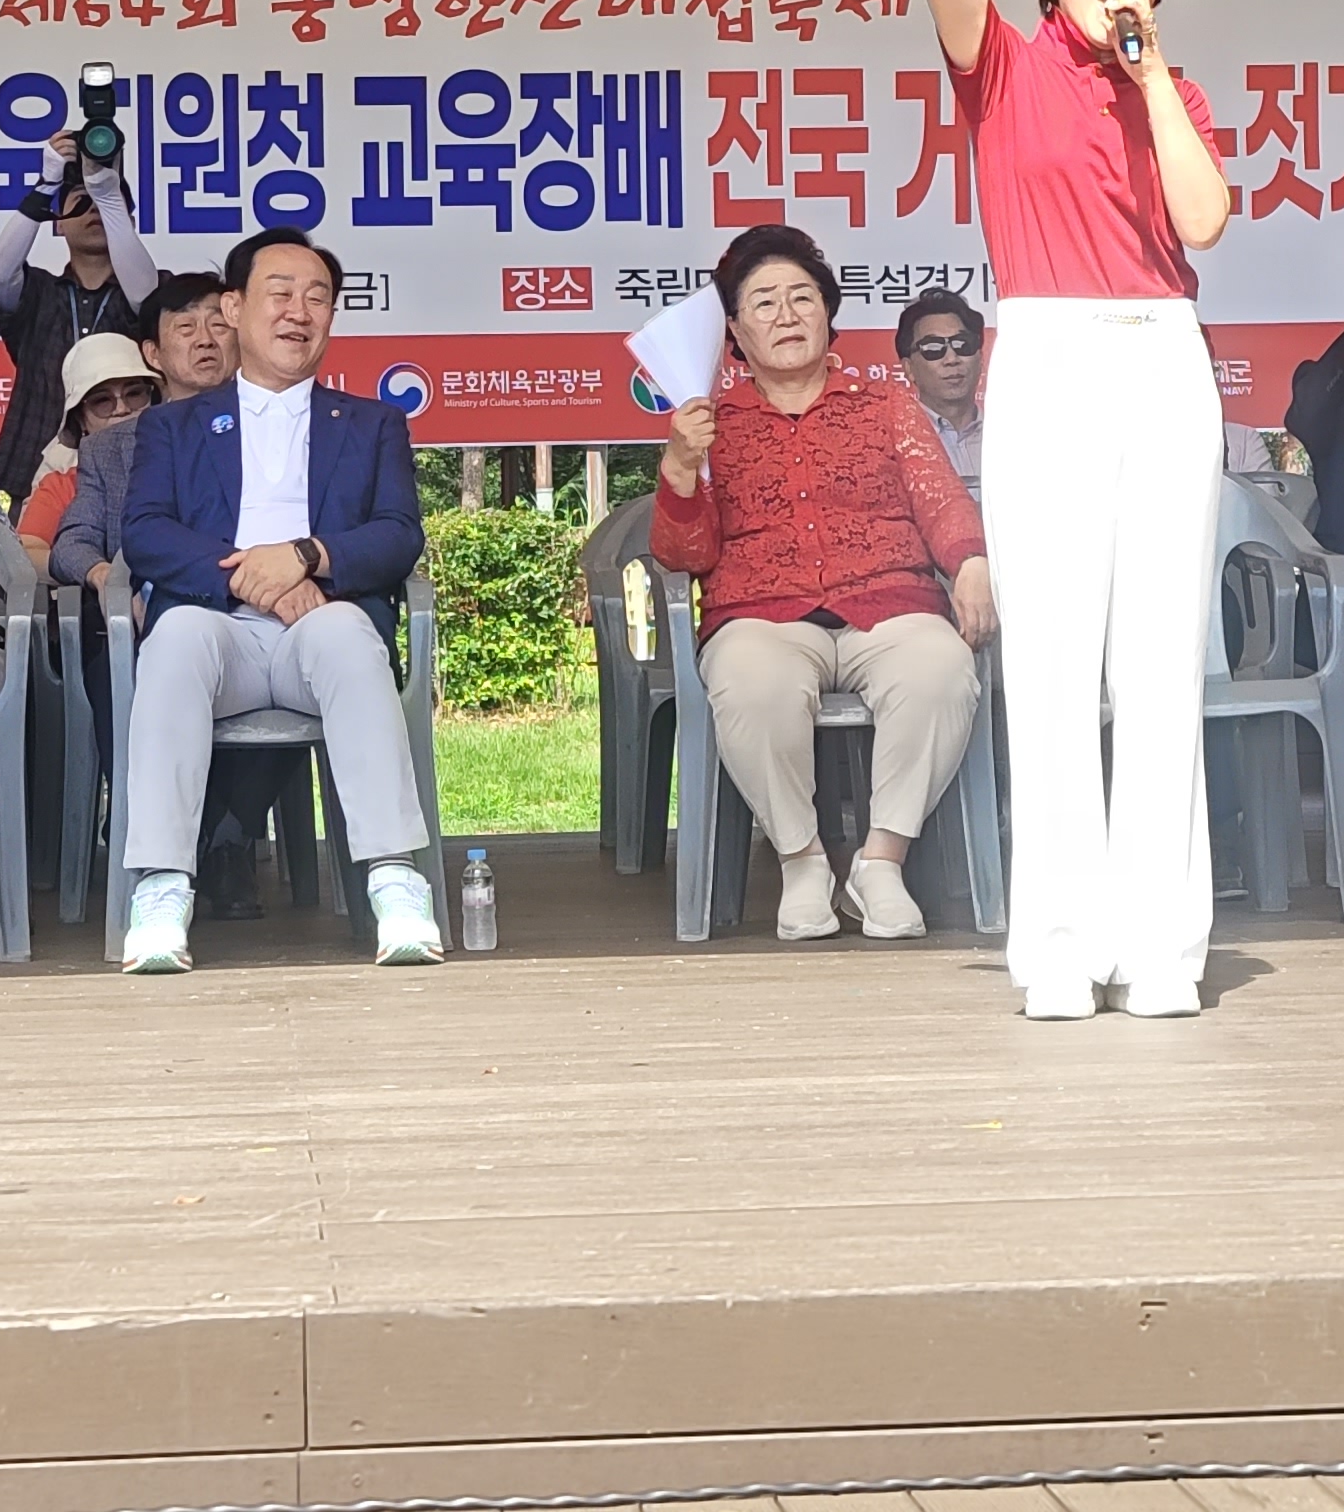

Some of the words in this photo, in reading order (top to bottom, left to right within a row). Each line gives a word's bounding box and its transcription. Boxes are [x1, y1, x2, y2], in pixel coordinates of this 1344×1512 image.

[352, 68, 683, 232] 교육장배
[707, 67, 869, 229] 전국
[508, 268, 590, 310] 장소
[614, 266, 713, 307] 죽림
[838, 262, 997, 305] 특설경기
[441, 369, 603, 395] 문화체육관광부
[1222, 386, 1253, 396] NAVY
[443, 398, 478, 409] Ministry
[479, 398, 489, 408] of
[522, 397, 550, 407] Sports
[550, 397, 567, 406] and
[568, 396, 602, 406] Tourism
